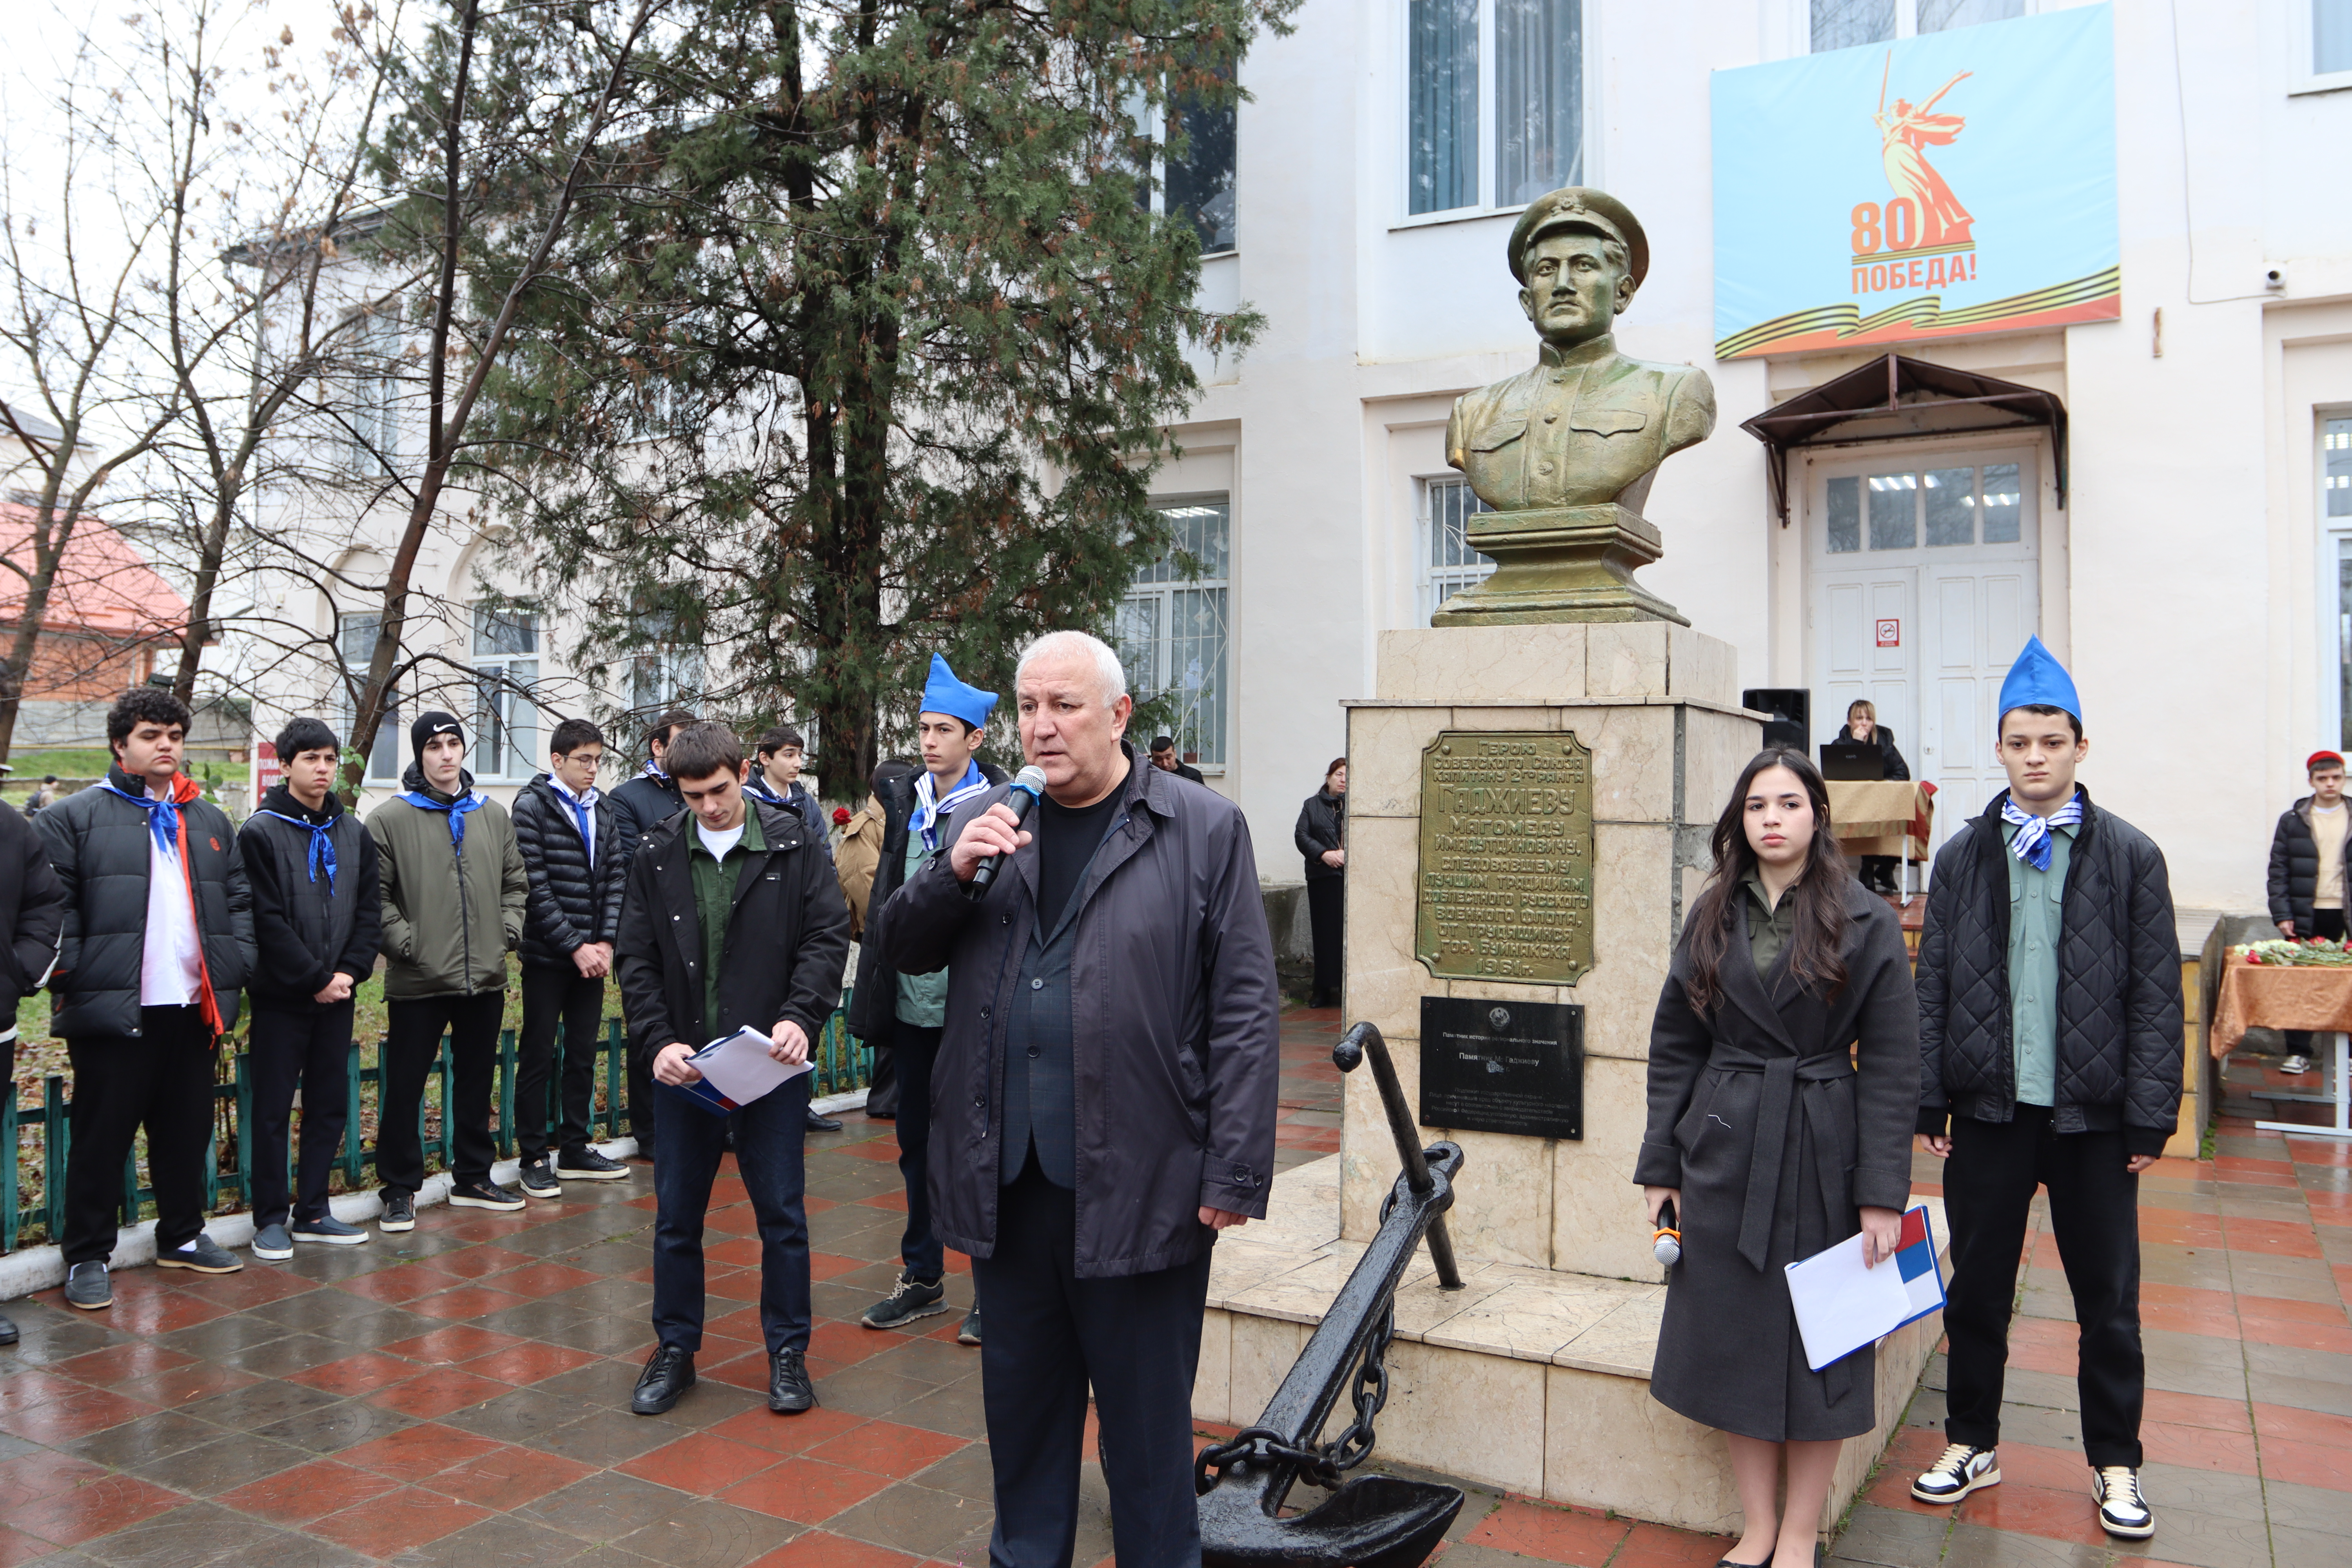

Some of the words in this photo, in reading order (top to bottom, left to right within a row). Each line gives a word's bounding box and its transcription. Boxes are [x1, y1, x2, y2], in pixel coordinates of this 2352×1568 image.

[1851, 197, 1916, 256] 80
[1852, 253, 1976, 294] ПОБЕДА!
[1433, 770, 1506, 782] КАПИТАНУ
[1537, 770, 1584, 783] РАНГА
[1441, 857, 1570, 874] СЛЕДОВАВШЕМУ
[1425, 872, 1488, 888] ЛУЧШИМ
[1497, 875, 1584, 891] ТРАДИЦИЯМ
[1422, 889, 1514, 906] ДОБЛЕСТНОГО
[1520, 893, 1589, 908] РУССКОГО
[1435, 906, 1515, 922] ВОЕННОГО
[1520, 908, 1582, 927] ФЛОТА,
[1438, 922, 1459, 936] ОТ
[1441, 939, 1474, 954] ГОР.
[1480, 939, 1571, 959] БУЙНАКСКА
[1459, 1052, 1493, 1062] Памятник
[1506, 1056, 1539, 1066] Гаджиеву
